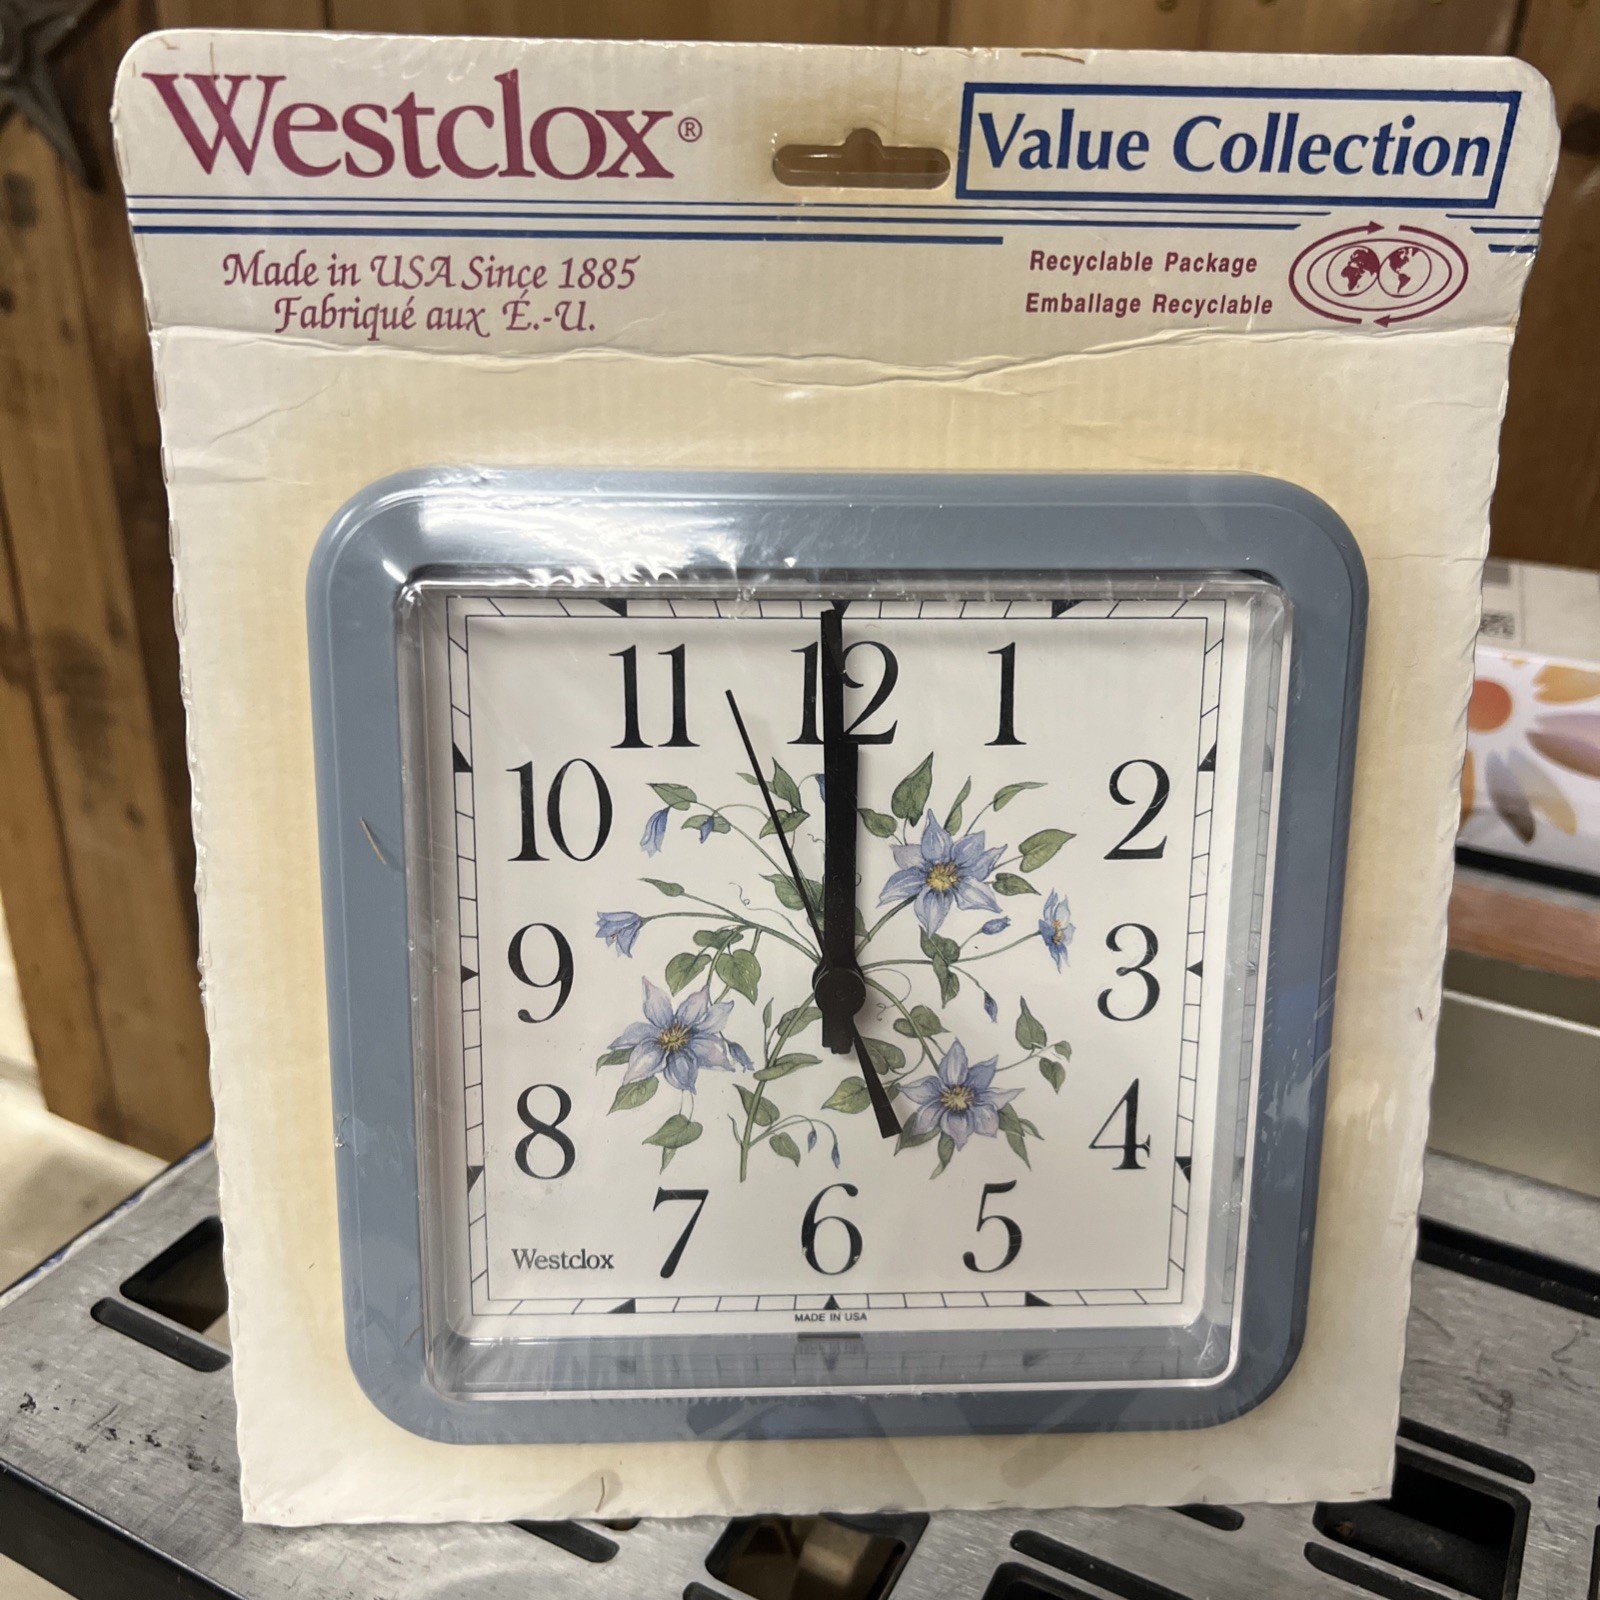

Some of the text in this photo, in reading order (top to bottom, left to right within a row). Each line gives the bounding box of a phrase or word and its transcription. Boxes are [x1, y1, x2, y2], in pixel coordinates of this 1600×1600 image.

[978, 108, 1490, 178] Value Collection
[222, 249, 642, 290] Made in USA Since 1885
[1025, 292, 1273, 319] Emballage Recyclable
[1029, 249, 1258, 278] Recyclable Package
[274, 292, 417, 342] Fabriqué
[426, 306, 491, 338] aux
[610, 643, 700, 749] 11
[787, 640, 899, 745] 12
[985, 641, 1027, 746] 1
[506, 758, 613, 862] 10
[1103, 759, 1171, 861] 2
[507, 922, 574, 1024] 9
[1097, 922, 1160, 1022] 3
[514, 1083, 576, 1180] 8
[1088, 1078, 1151, 1171] 4
[511, 1247, 615, 1271] Westclox
[652, 1186, 710, 1279] 7
[800, 1182, 863, 1276] 6
[962, 1179, 1023, 1274] 5
[794, 1312, 868, 1322] MADE IN USA
